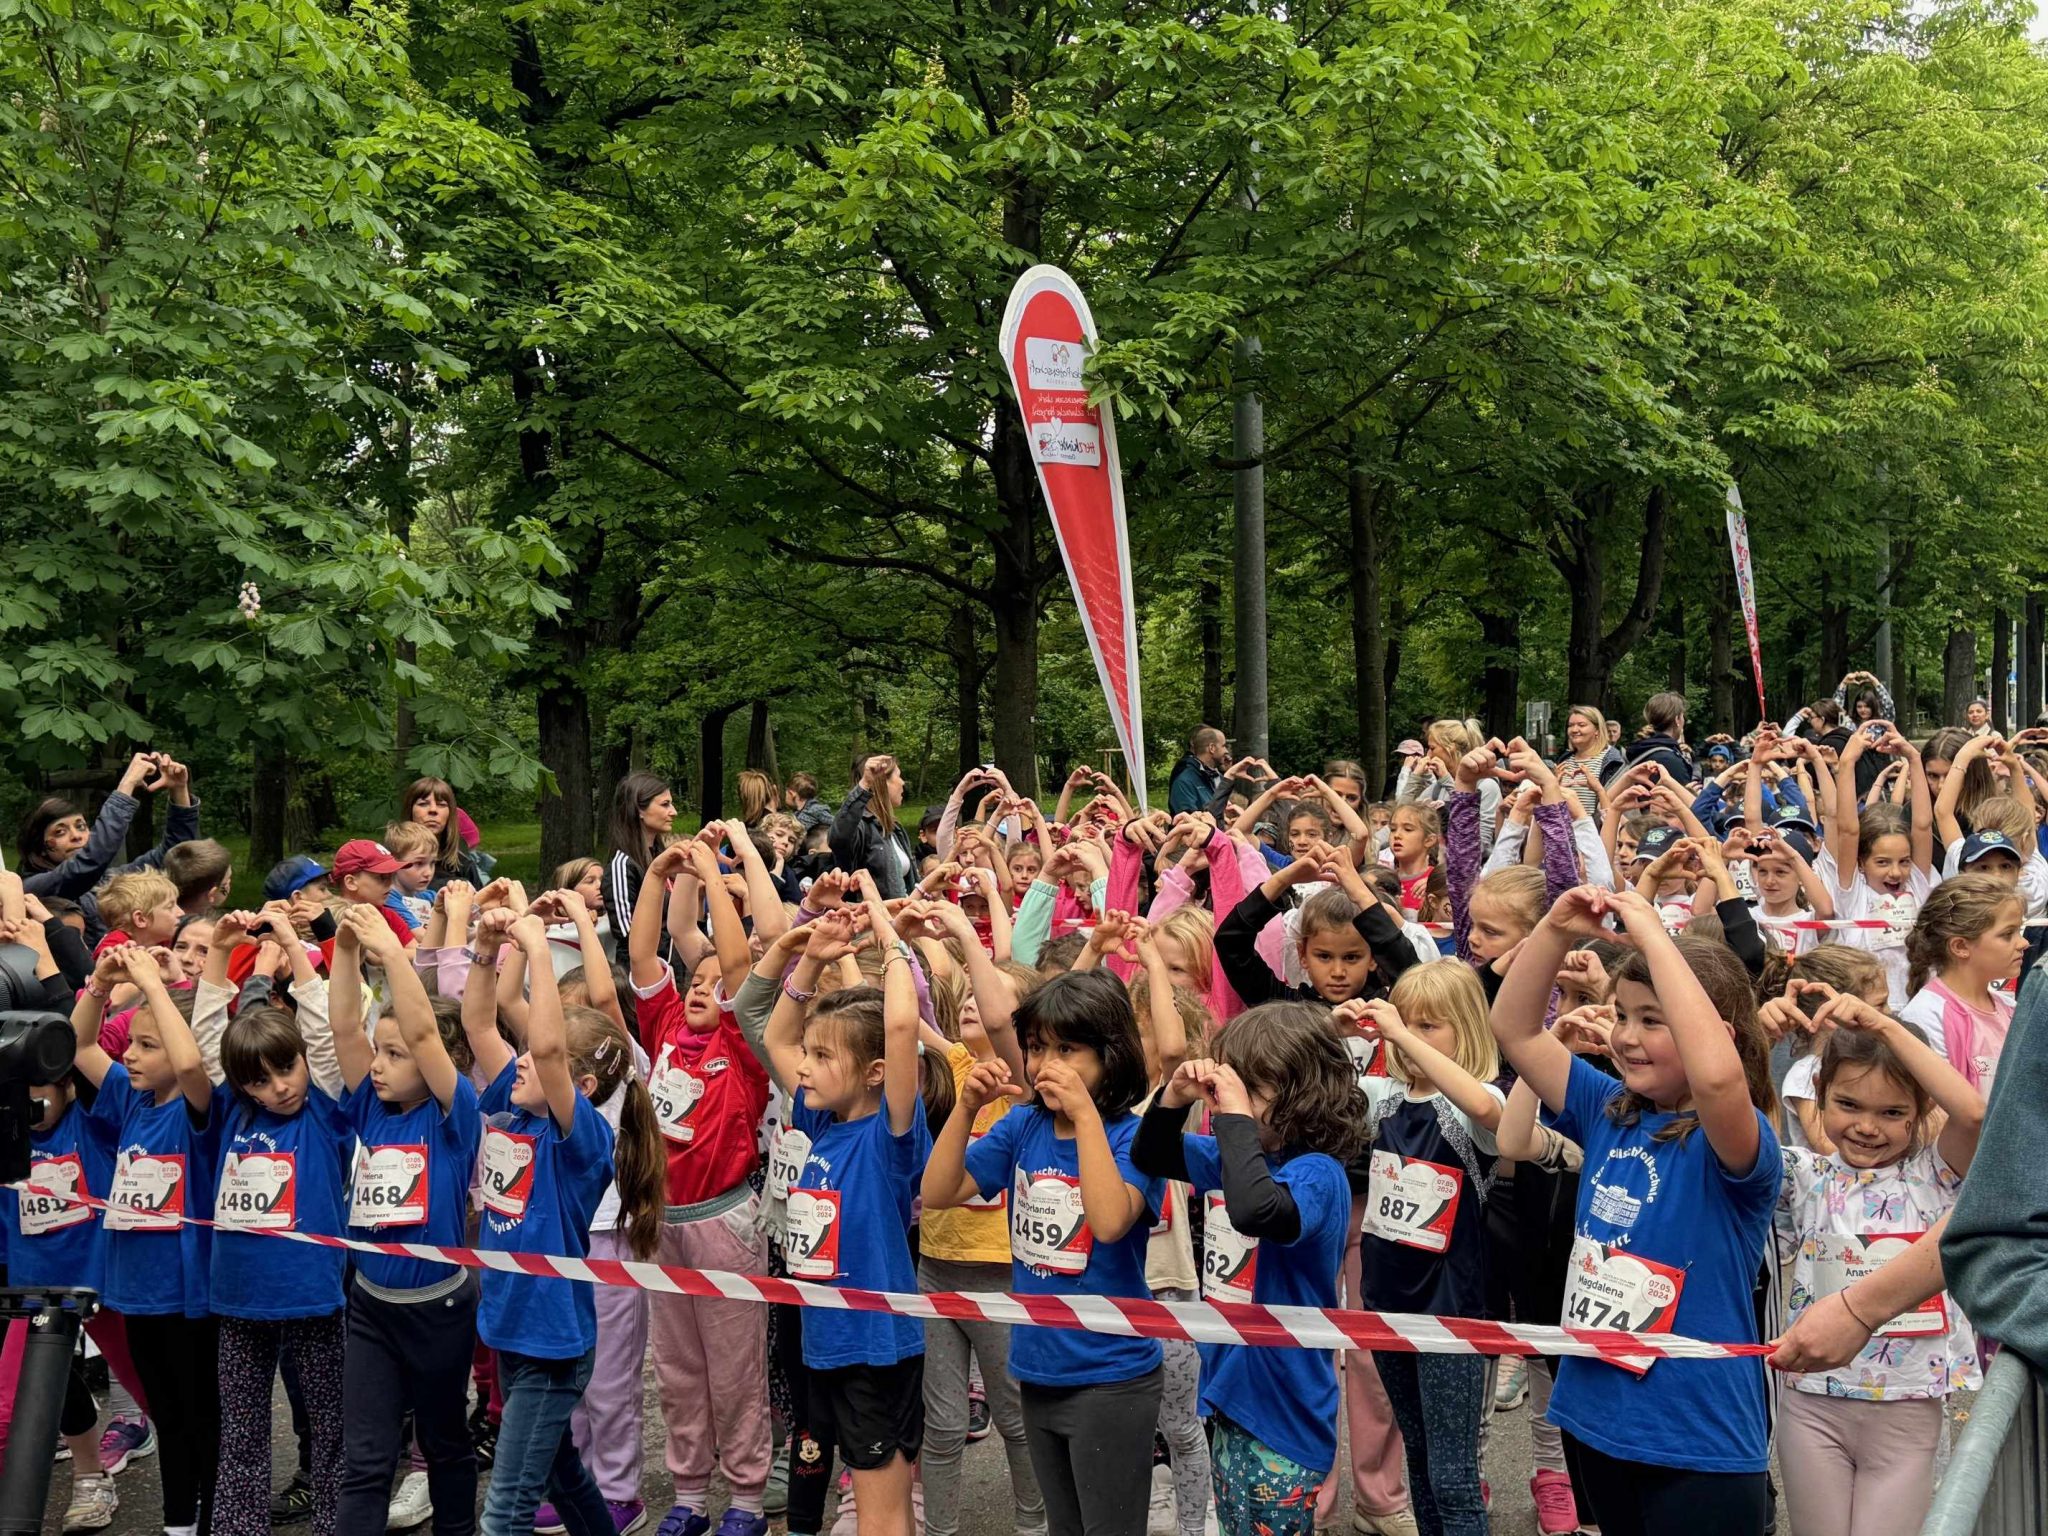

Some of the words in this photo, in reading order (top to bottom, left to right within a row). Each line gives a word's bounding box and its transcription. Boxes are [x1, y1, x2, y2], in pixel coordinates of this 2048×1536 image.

[122, 1179, 139, 1188] Anna
[230, 1178, 249, 1188] Olivia
[362, 1172, 384, 1181] Helena
[484, 1166, 505, 1192] 78
[355, 1185, 401, 1207] 1468
[1392, 1183, 1405, 1193] Ina
[1436, 1186, 1453, 1194] 2024
[112, 1192, 156, 1211] 1461
[219, 1191, 269, 1212] 1480
[1380, 1196, 1421, 1224] 887
[816, 1210, 833, 1218] 2024
[1015, 1213, 1063, 1248] 1459
[787, 1230, 811, 1256] 73
[1205, 1249, 1231, 1280] 62
[1578, 1273, 1625, 1299] Magdalena
[1647, 1288, 1669, 1301] 2024
[32, 1314, 50, 1327] dji
[1568, 1291, 1632, 1332] 1474
